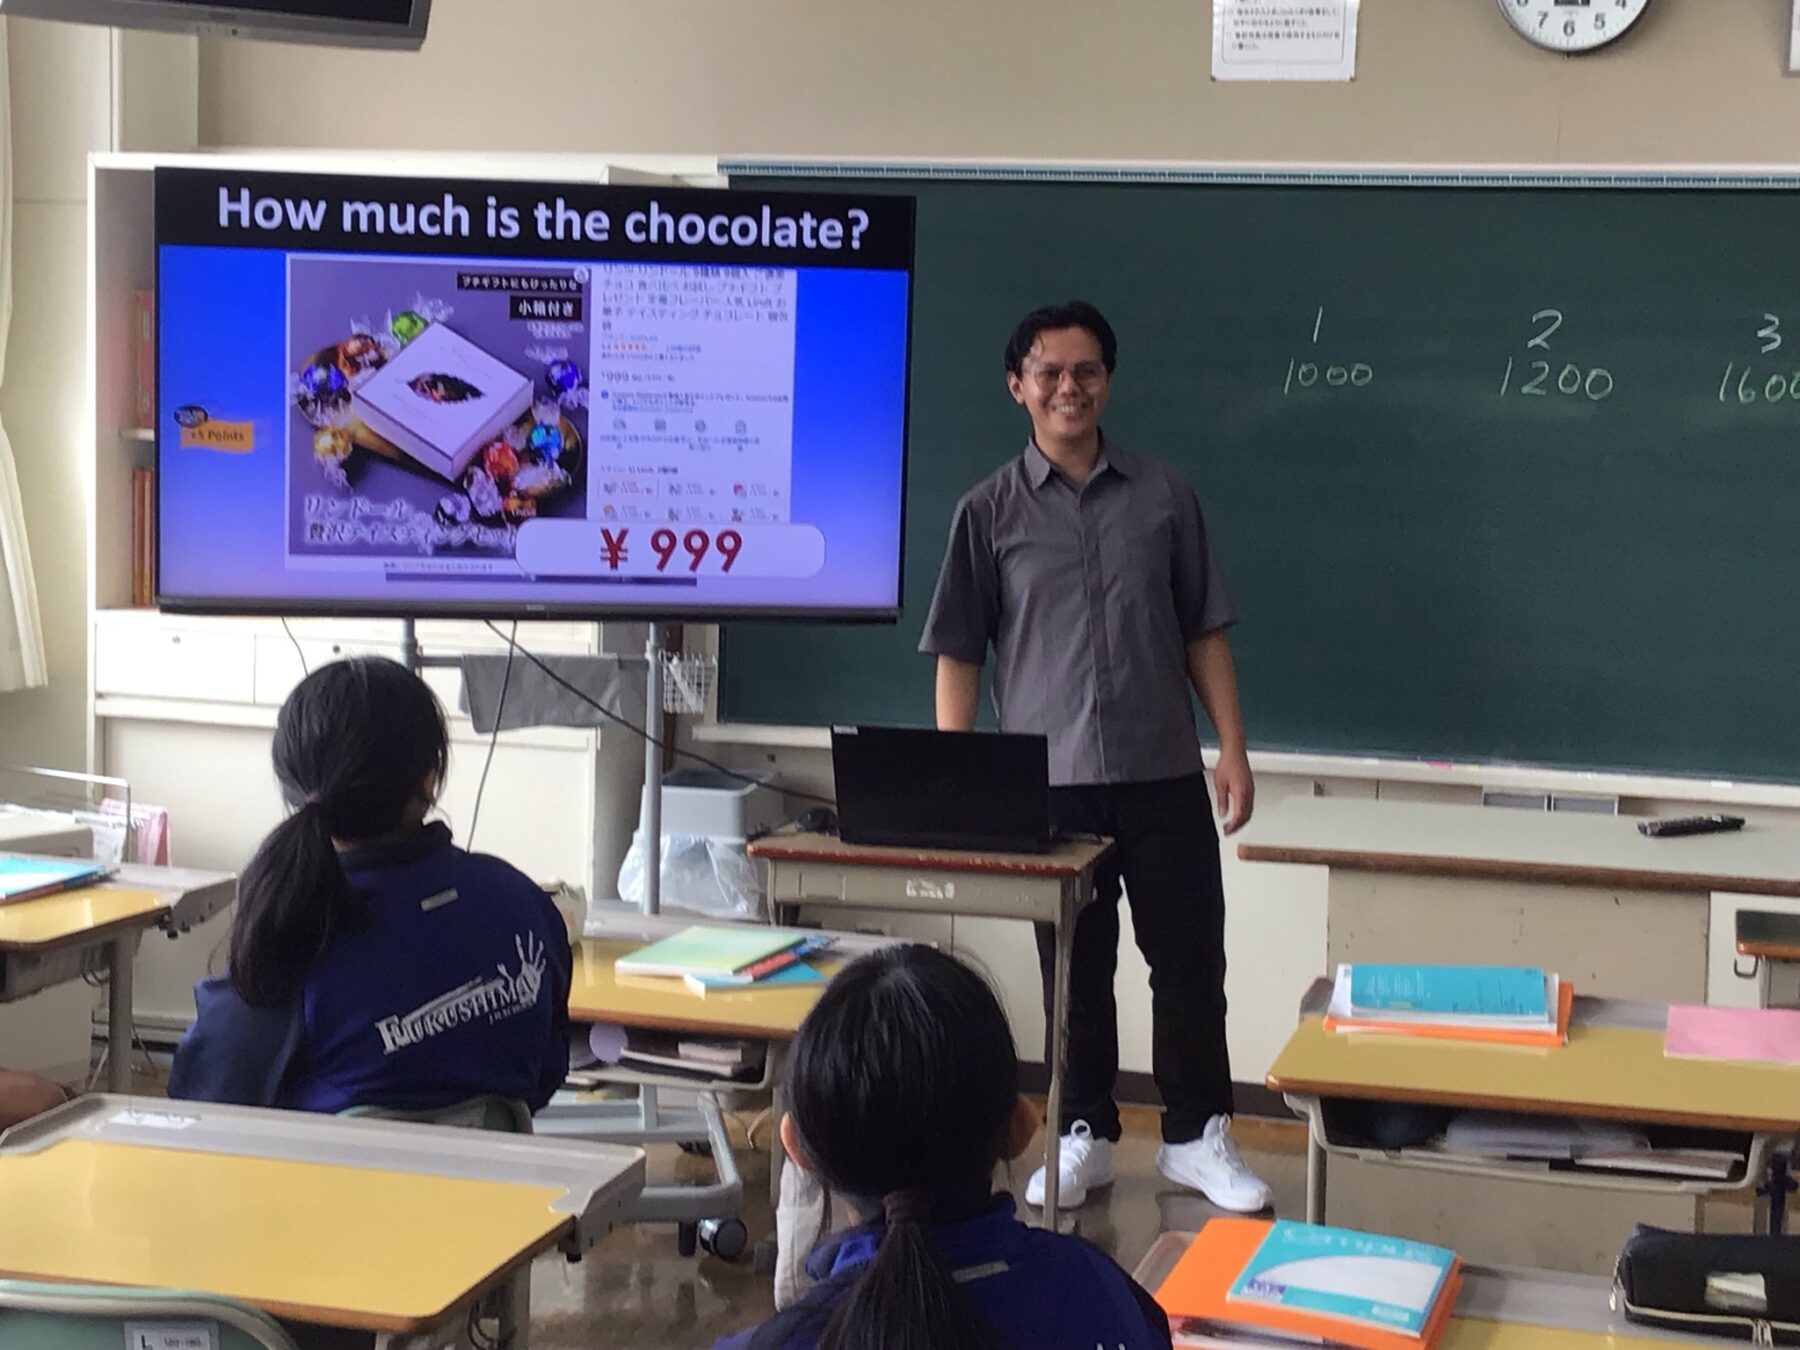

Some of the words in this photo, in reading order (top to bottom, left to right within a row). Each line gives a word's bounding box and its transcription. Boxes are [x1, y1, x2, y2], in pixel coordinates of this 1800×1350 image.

[1537, 11, 1548, 28] 7
[1563, 19, 1576, 37] 6
[1593, 12, 1606, 30] 5
[219, 186, 327, 231] How
[342, 193, 470, 237] much
[486, 195, 520, 239] is
[533, 197, 610, 241] the
[625, 201, 870, 250] chocolate?
[518, 299, 574, 317] 小箱付き
[1312, 305, 1323, 344] 1
[1527, 309, 1563, 350] 2
[1757, 312, 1782, 353] 3
[1283, 358, 1373, 395] 1000
[1500, 356, 1614, 401] 1200
[208, 429, 245, 442] Points
[600, 528, 629, 571] ¥
[650, 528, 743, 573] 999
